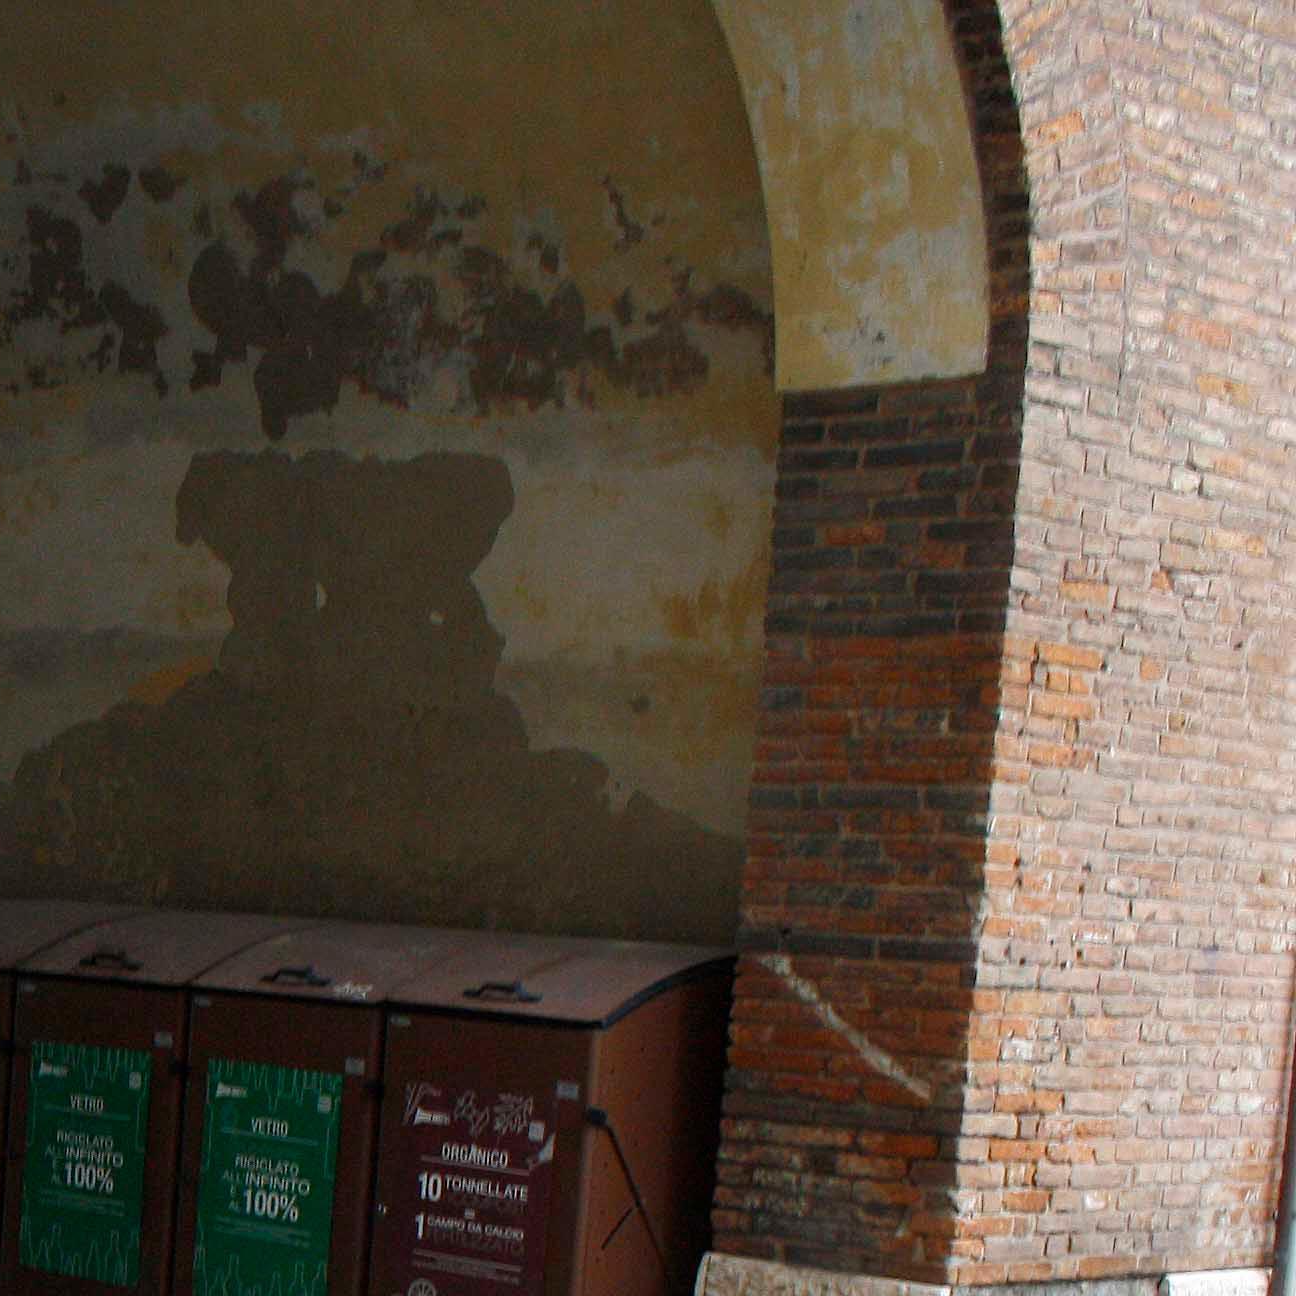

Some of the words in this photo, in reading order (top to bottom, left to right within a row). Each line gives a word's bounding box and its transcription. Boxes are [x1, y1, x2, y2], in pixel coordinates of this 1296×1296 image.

[69, 1093, 105, 1113] VETRO
[56, 1129, 114, 1150] RICICLATO
[250, 1116, 289, 1138] VETRO
[65, 1144, 124, 1168] INFINITO
[234, 1153, 300, 1177] RICICLATO
[441, 1141, 509, 1169] ORGANICO
[64, 1161, 114, 1194] 100%
[244, 1170, 311, 1197] INFINITO
[418, 1170, 442, 1202] 10
[444, 1173, 529, 1202] TONNELLATE
[243, 1188, 299, 1223] 100%
[415, 1211, 425, 1241] 1
[426, 1213, 465, 1232] CAMPO
[466, 1220, 482, 1233] DA
[484, 1223, 525, 1242] CALCIO
